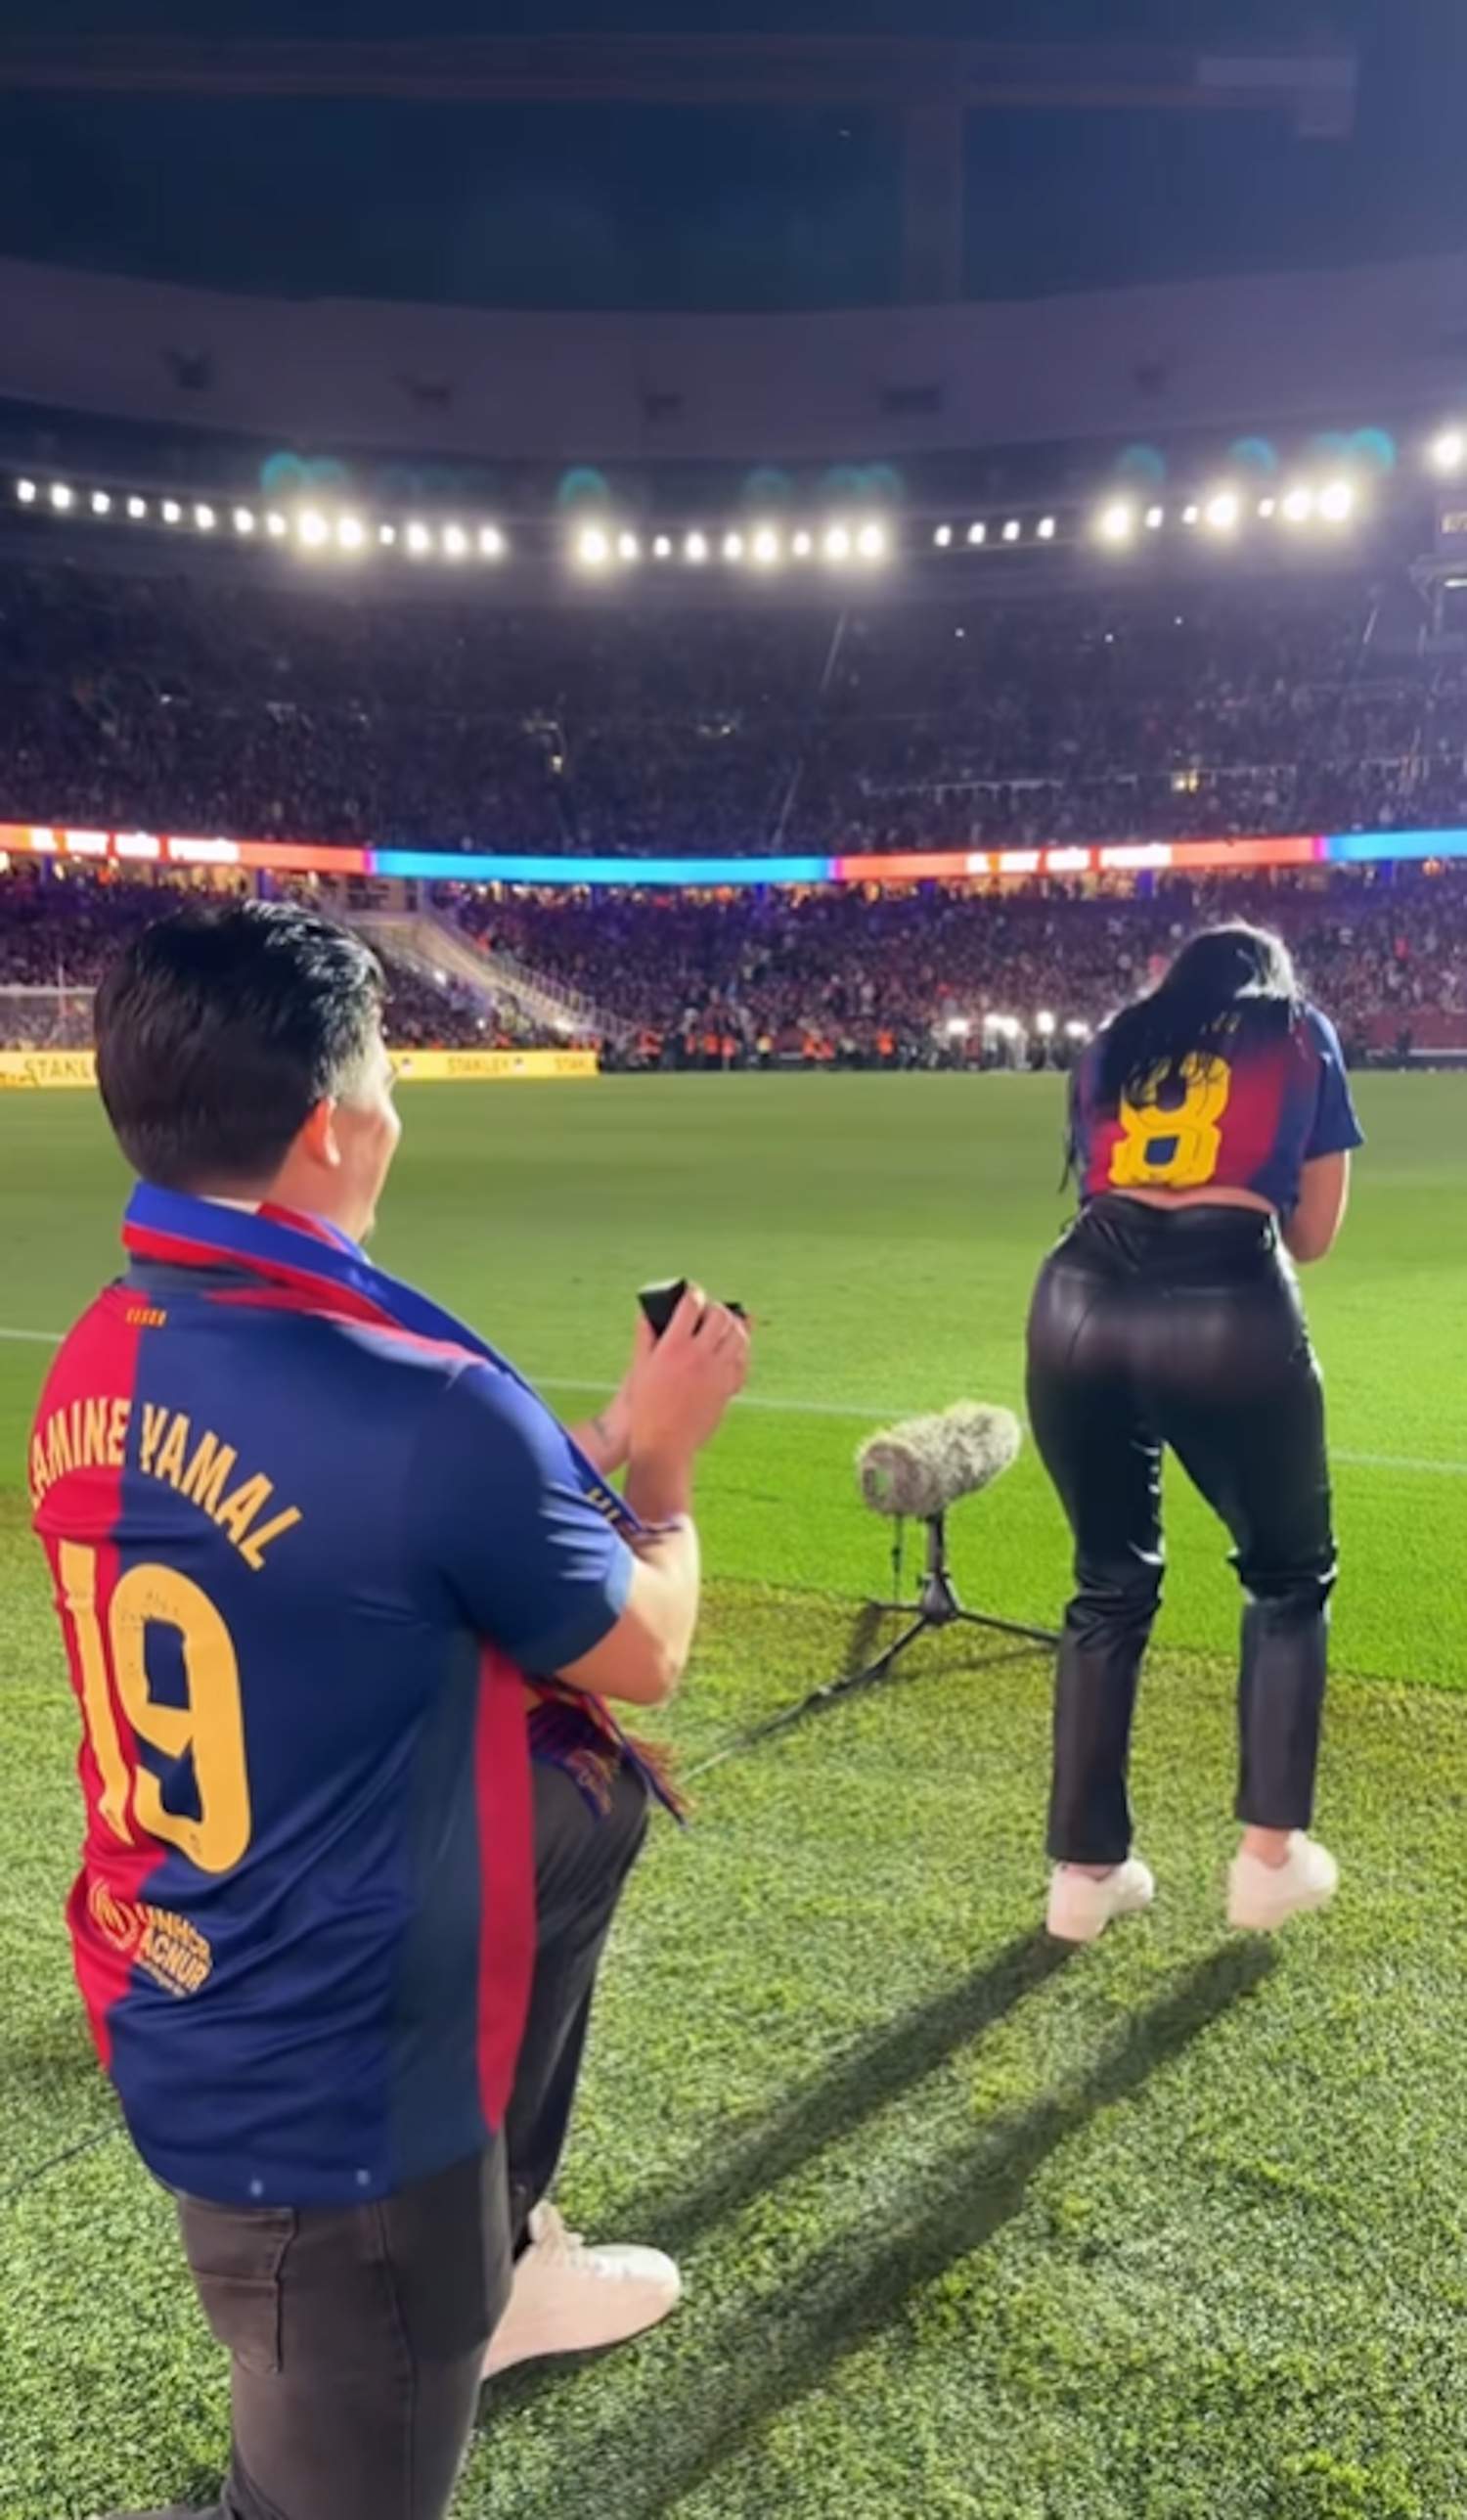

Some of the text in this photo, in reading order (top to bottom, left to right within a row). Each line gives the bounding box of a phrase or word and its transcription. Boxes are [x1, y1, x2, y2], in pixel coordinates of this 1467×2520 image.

[23, 1058, 92, 1080] STANL
[1108, 1051, 1231, 1188] 8
[31, 1397, 303, 1570] AMINE YAMAL
[59, 1539, 251, 1874] 19
